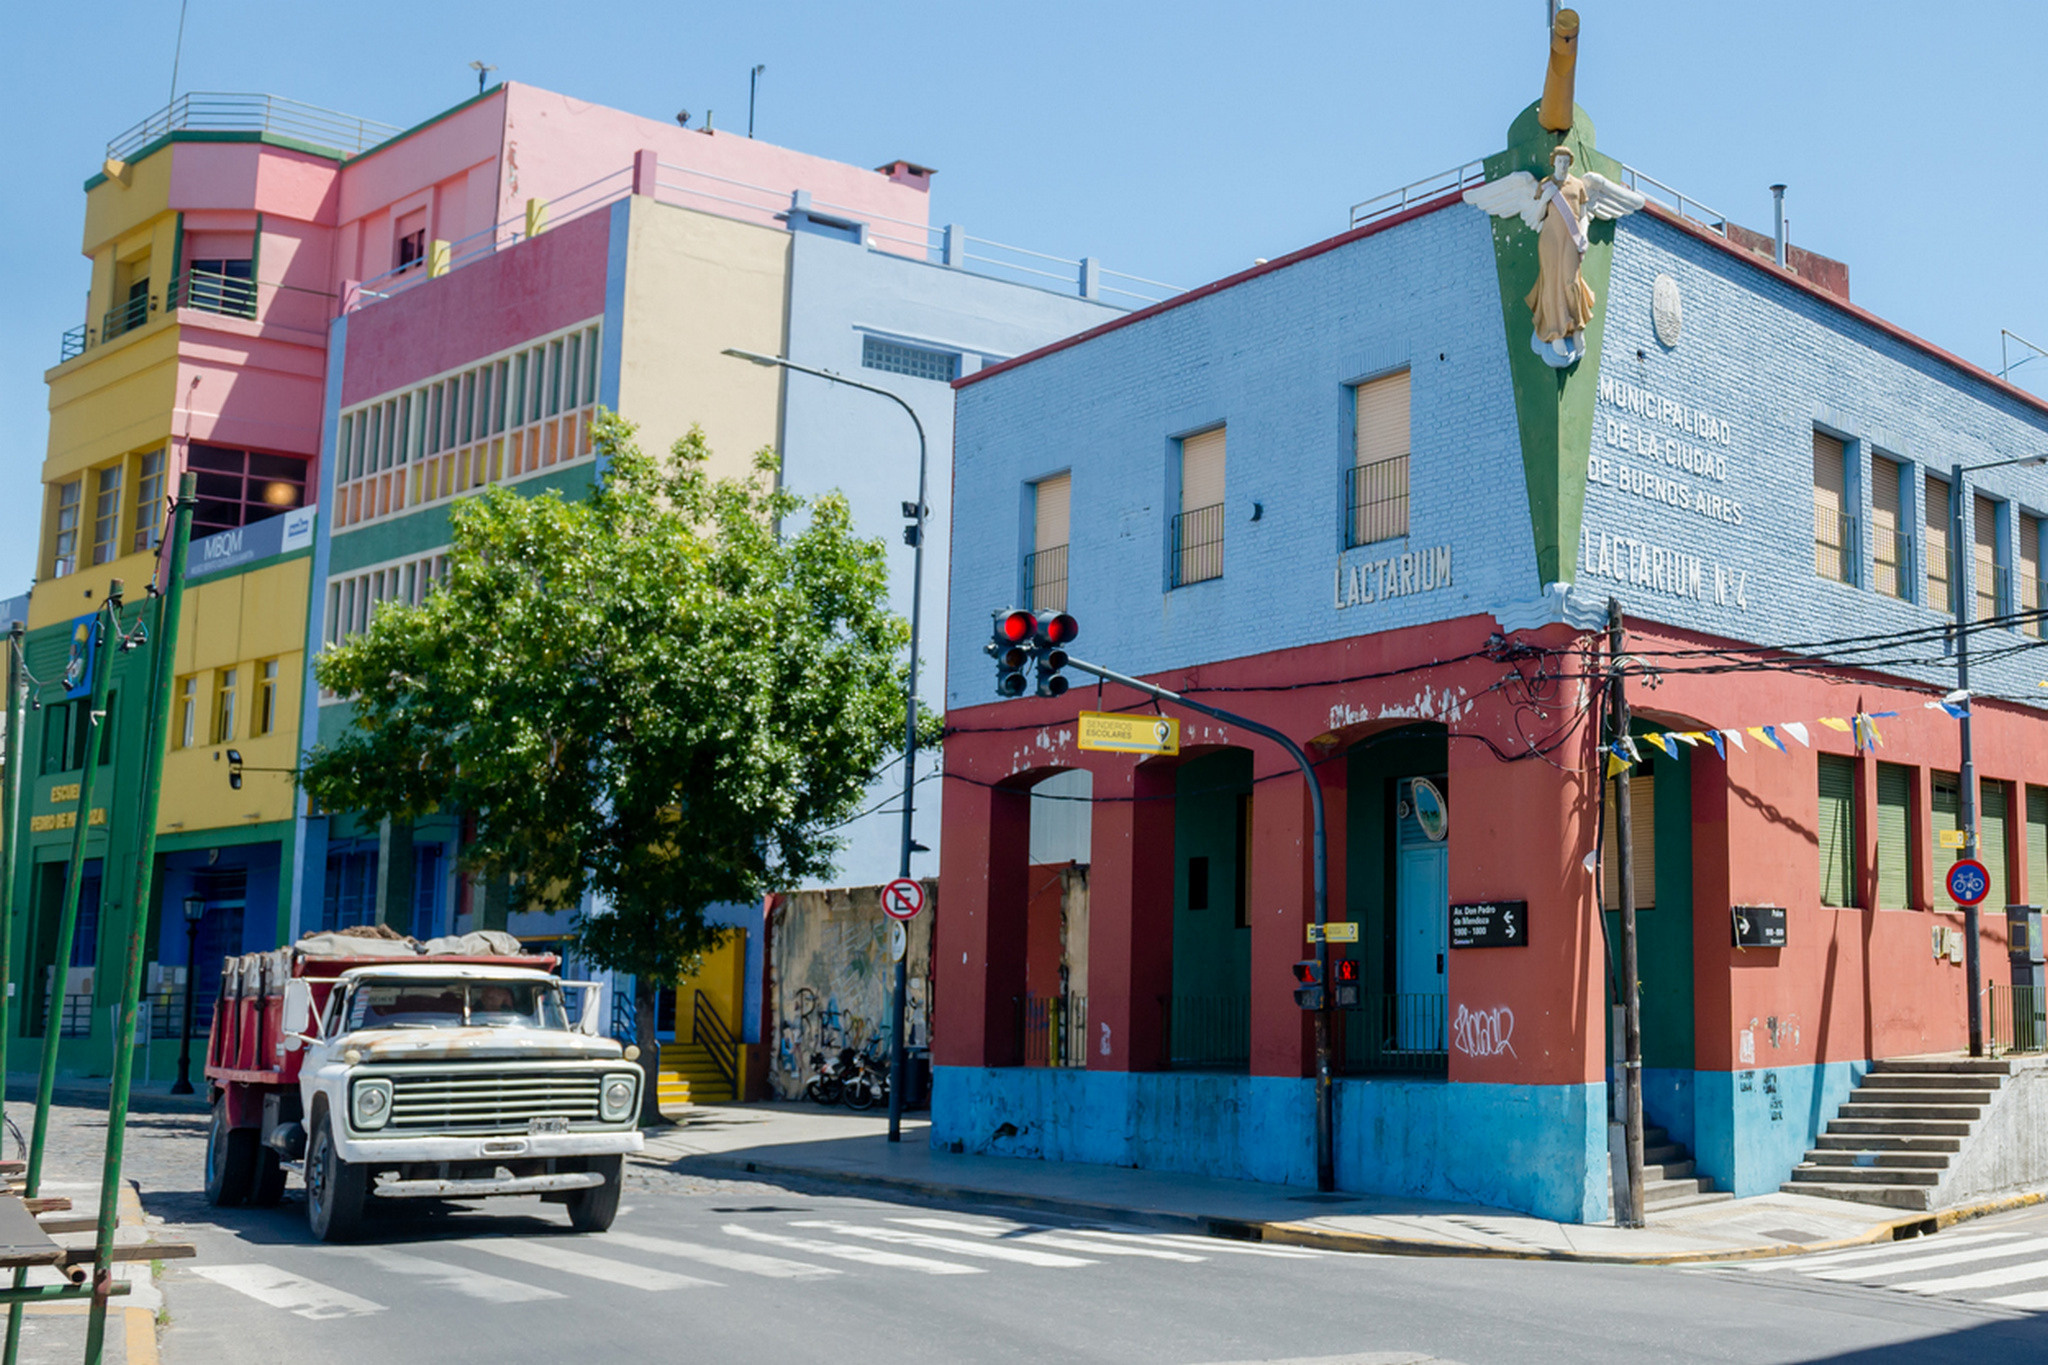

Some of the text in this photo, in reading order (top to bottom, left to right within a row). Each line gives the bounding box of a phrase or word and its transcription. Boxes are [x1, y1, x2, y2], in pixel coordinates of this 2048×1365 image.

[1600, 376, 1730, 445] MUNICIPALIDAD
[1606, 419, 1726, 481] DE LA CIUDAD
[1587, 455, 1742, 525] DE BUENOS AIRES
[204, 529, 243, 561] MBQM
[1335, 544, 1452, 609] LACTARIUM
[1585, 527, 1701, 600] LACTARIUM
[1086, 719, 1132, 731] SENDEROS
[1086, 729, 1132, 739] ESCOLARES
[30, 814, 56, 832] PEDRO
[1462, 916, 1490, 925] Mendoza
[1464, 906, 1477, 915] Don
[1478, 905, 1496, 914] Pedro
